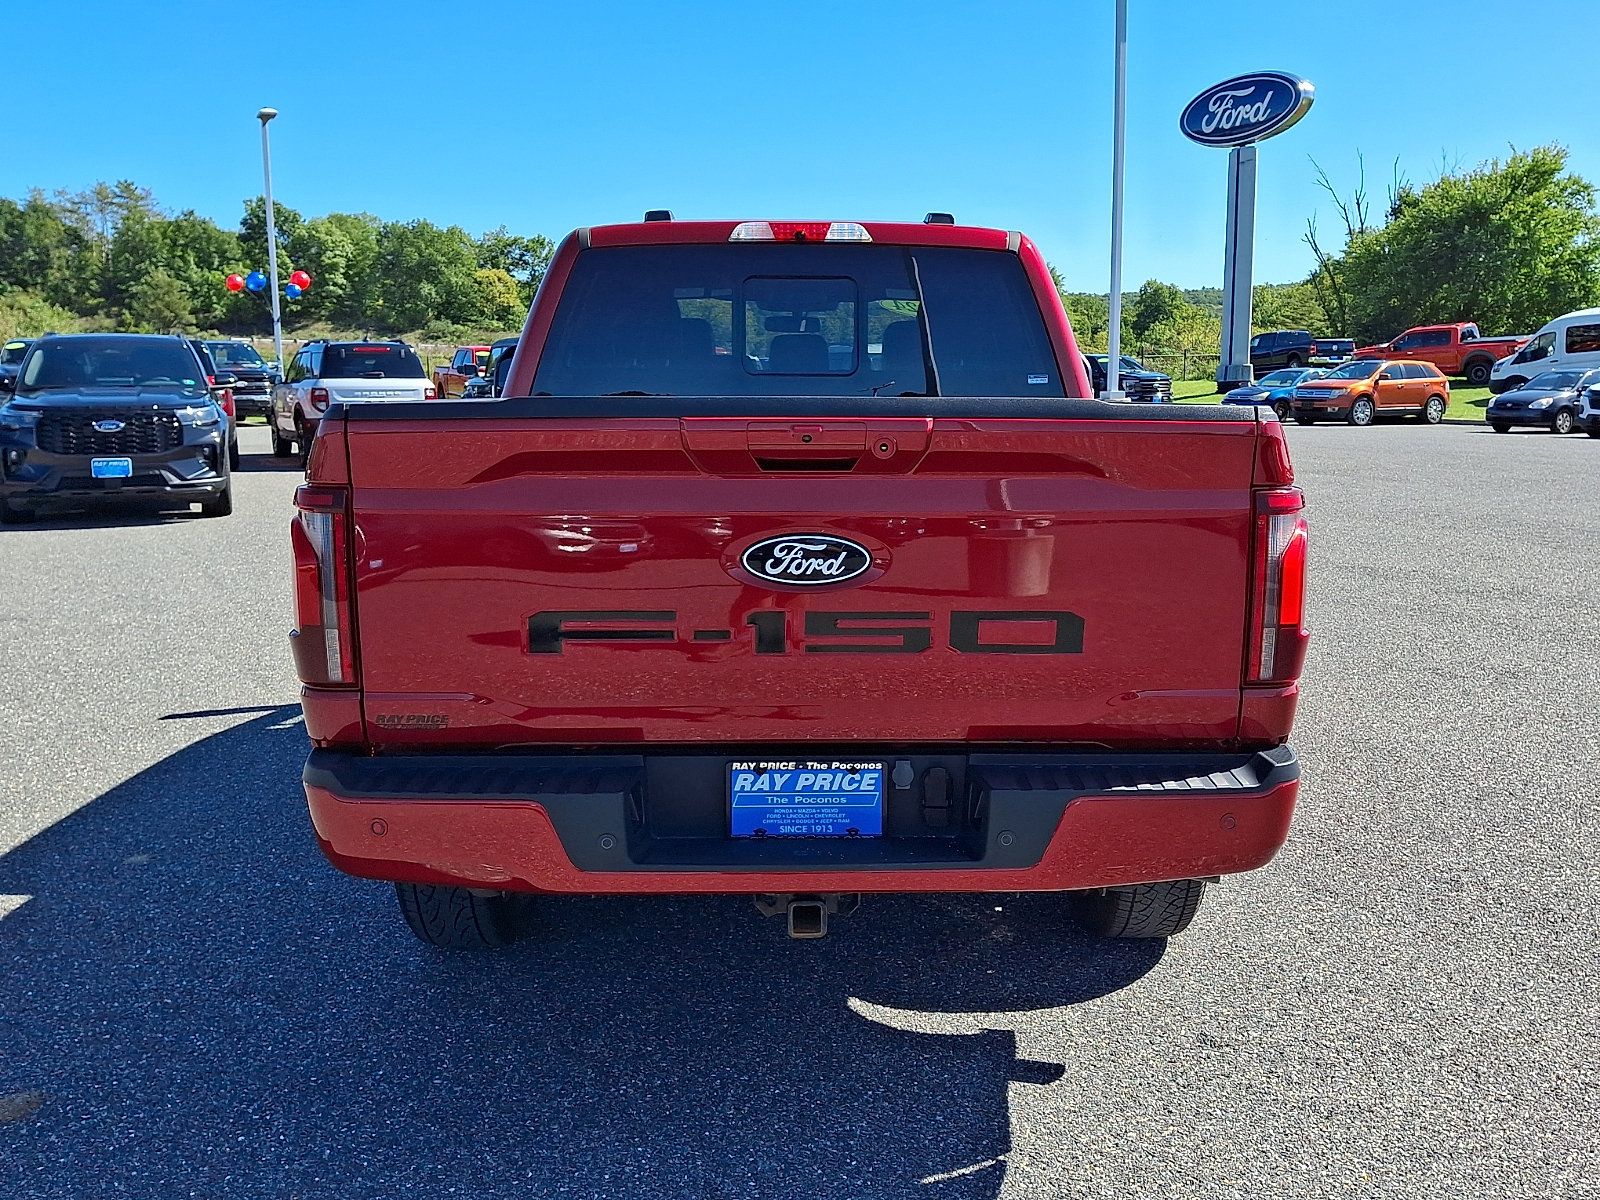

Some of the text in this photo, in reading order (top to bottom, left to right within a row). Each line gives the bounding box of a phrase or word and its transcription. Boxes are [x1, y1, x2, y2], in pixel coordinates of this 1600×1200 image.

[1201, 85, 1274, 134] Ford
[765, 542, 847, 575] Ford
[527, 610, 1086, 654] F-150
[376, 714, 449, 724] RAY PRICE
[732, 762, 757, 770] RAY
[759, 762, 797, 770] PRICE
[806, 761, 828, 770] The
[831, 761, 883, 770] Poconos
[733, 773, 879, 791] RAY PRICE
[765, 796, 847, 804] The Poconos
[779, 825, 833, 833] SINCE 1913
